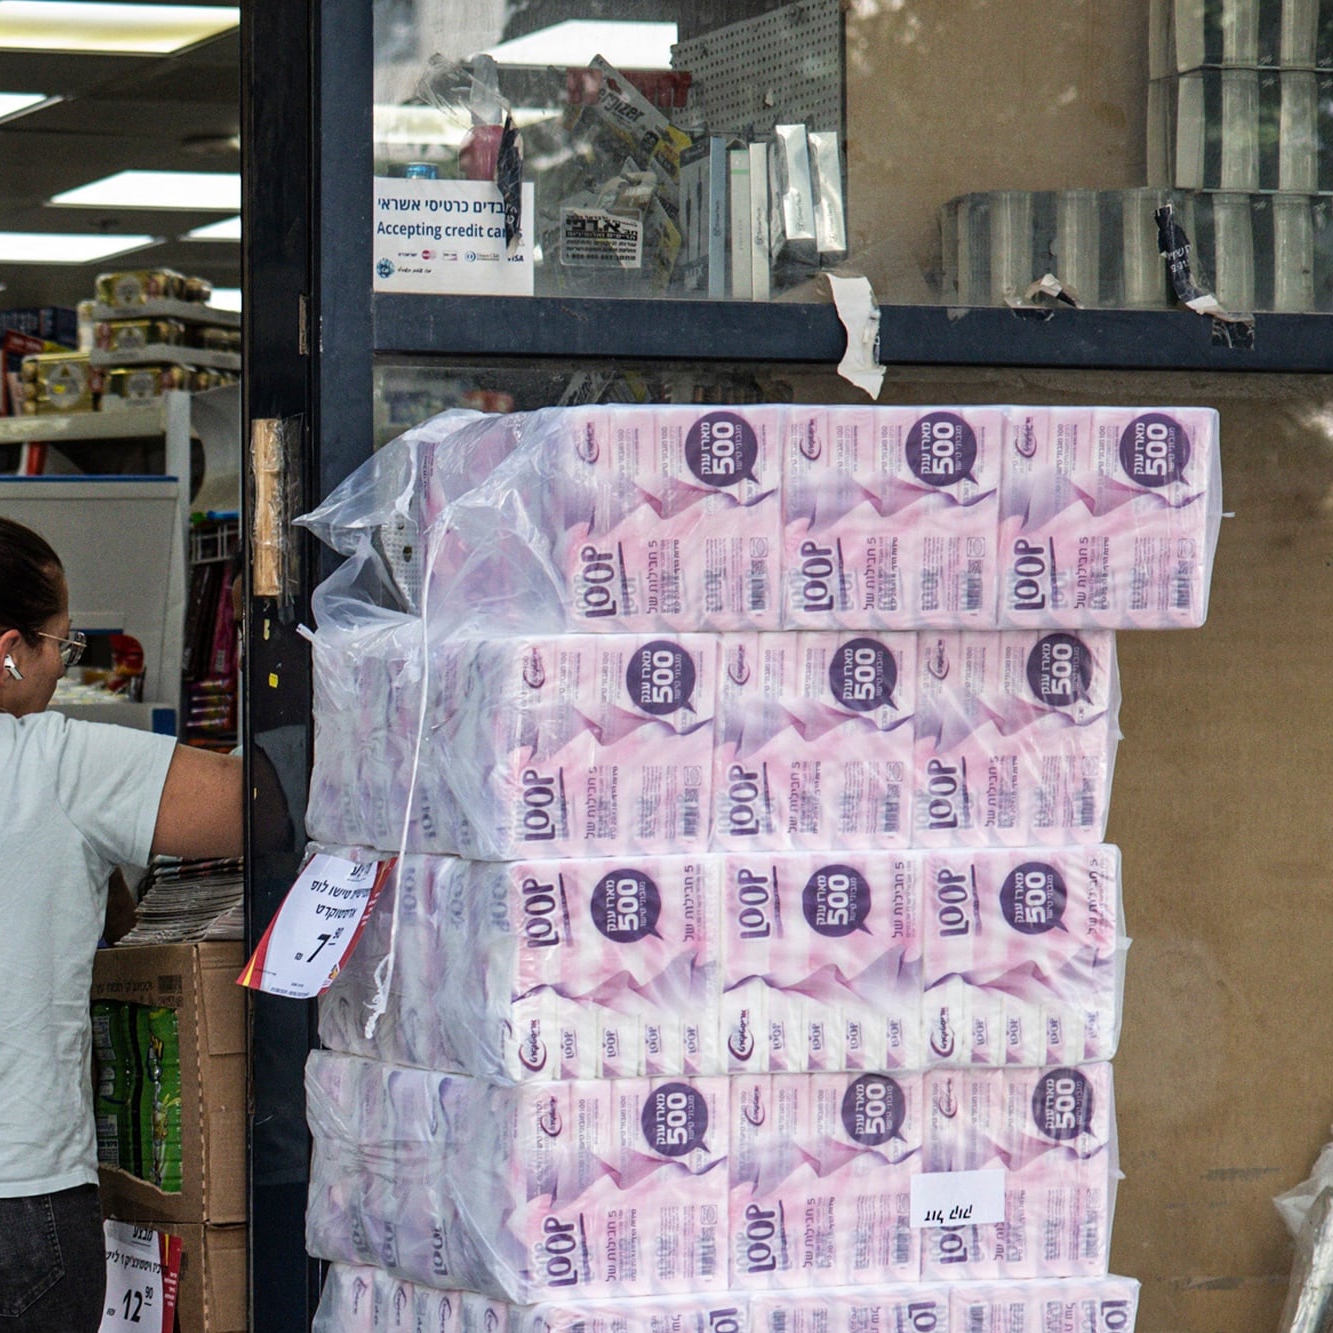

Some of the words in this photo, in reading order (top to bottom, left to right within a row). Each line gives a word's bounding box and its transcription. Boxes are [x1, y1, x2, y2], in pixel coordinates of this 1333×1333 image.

[599, 88, 645, 122] ergizer
[378, 197, 420, 211] אשראי
[425, 199, 469, 213] כרטיסי
[473, 201, 505, 214] בדים
[377, 221, 442, 240] Accepting
[445, 223, 484, 238] credit
[487, 227, 523, 238] cars
[711, 421, 735, 474] 500
[931, 421, 954, 474] 500
[1144, 421, 1167, 474] 500
[650, 649, 673, 702] 500
[854, 647, 877, 701] 500
[1052, 642, 1073, 694] 500
[617, 879, 639, 931] 500
[827, 873, 850, 926] 500
[1025, 871, 1047, 924] 500
[307, 933, 332, 963] 7
[665, 1091, 688, 1145] 500
[865, 1082, 887, 1136] 500
[1055, 1078, 1075, 1130] 500
[122, 1288, 143, 1323] 12
